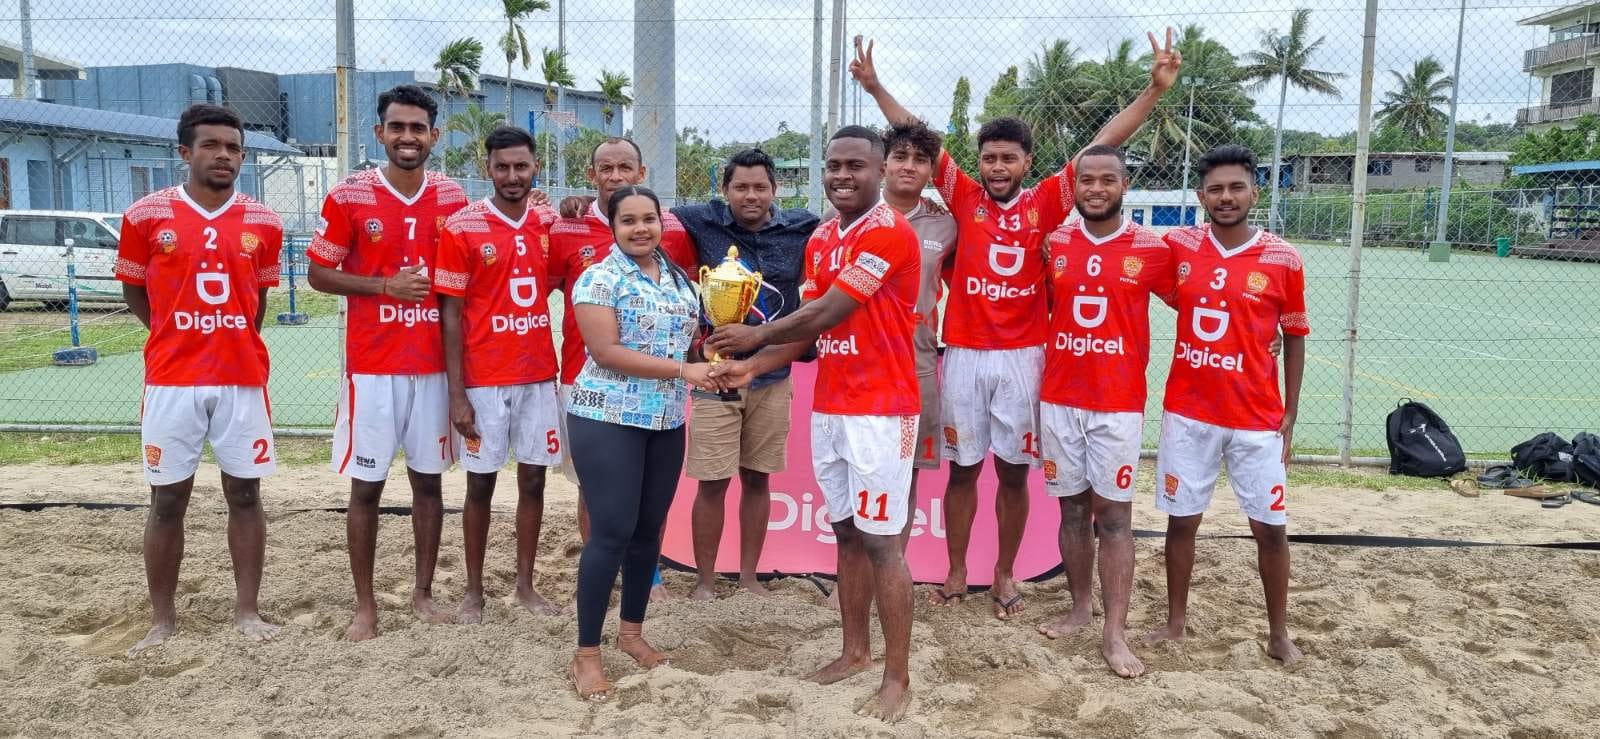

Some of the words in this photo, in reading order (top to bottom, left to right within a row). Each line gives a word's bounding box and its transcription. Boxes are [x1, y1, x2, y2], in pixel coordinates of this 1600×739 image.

[404, 217, 417, 240] 7
[998, 214, 1021, 232] 13
[203, 226, 218, 250] 2
[514, 235, 527, 257] 5
[1086, 254, 1102, 277] 6
[1209, 267, 1228, 290] 3
[174, 309, 247, 334] Digice
[379, 303, 440, 328] Digice
[491, 311, 550, 336] Digice
[1055, 332, 1125, 357] Digicel
[1176, 341, 1244, 373] Digicel
[252, 438, 271, 465] 2
[438, 435, 448, 460] 7
[546, 429, 560, 455] 5
[1115, 464, 1132, 489] 6
[857, 490, 890, 522] 11
[1270, 485, 1286, 511] 2
